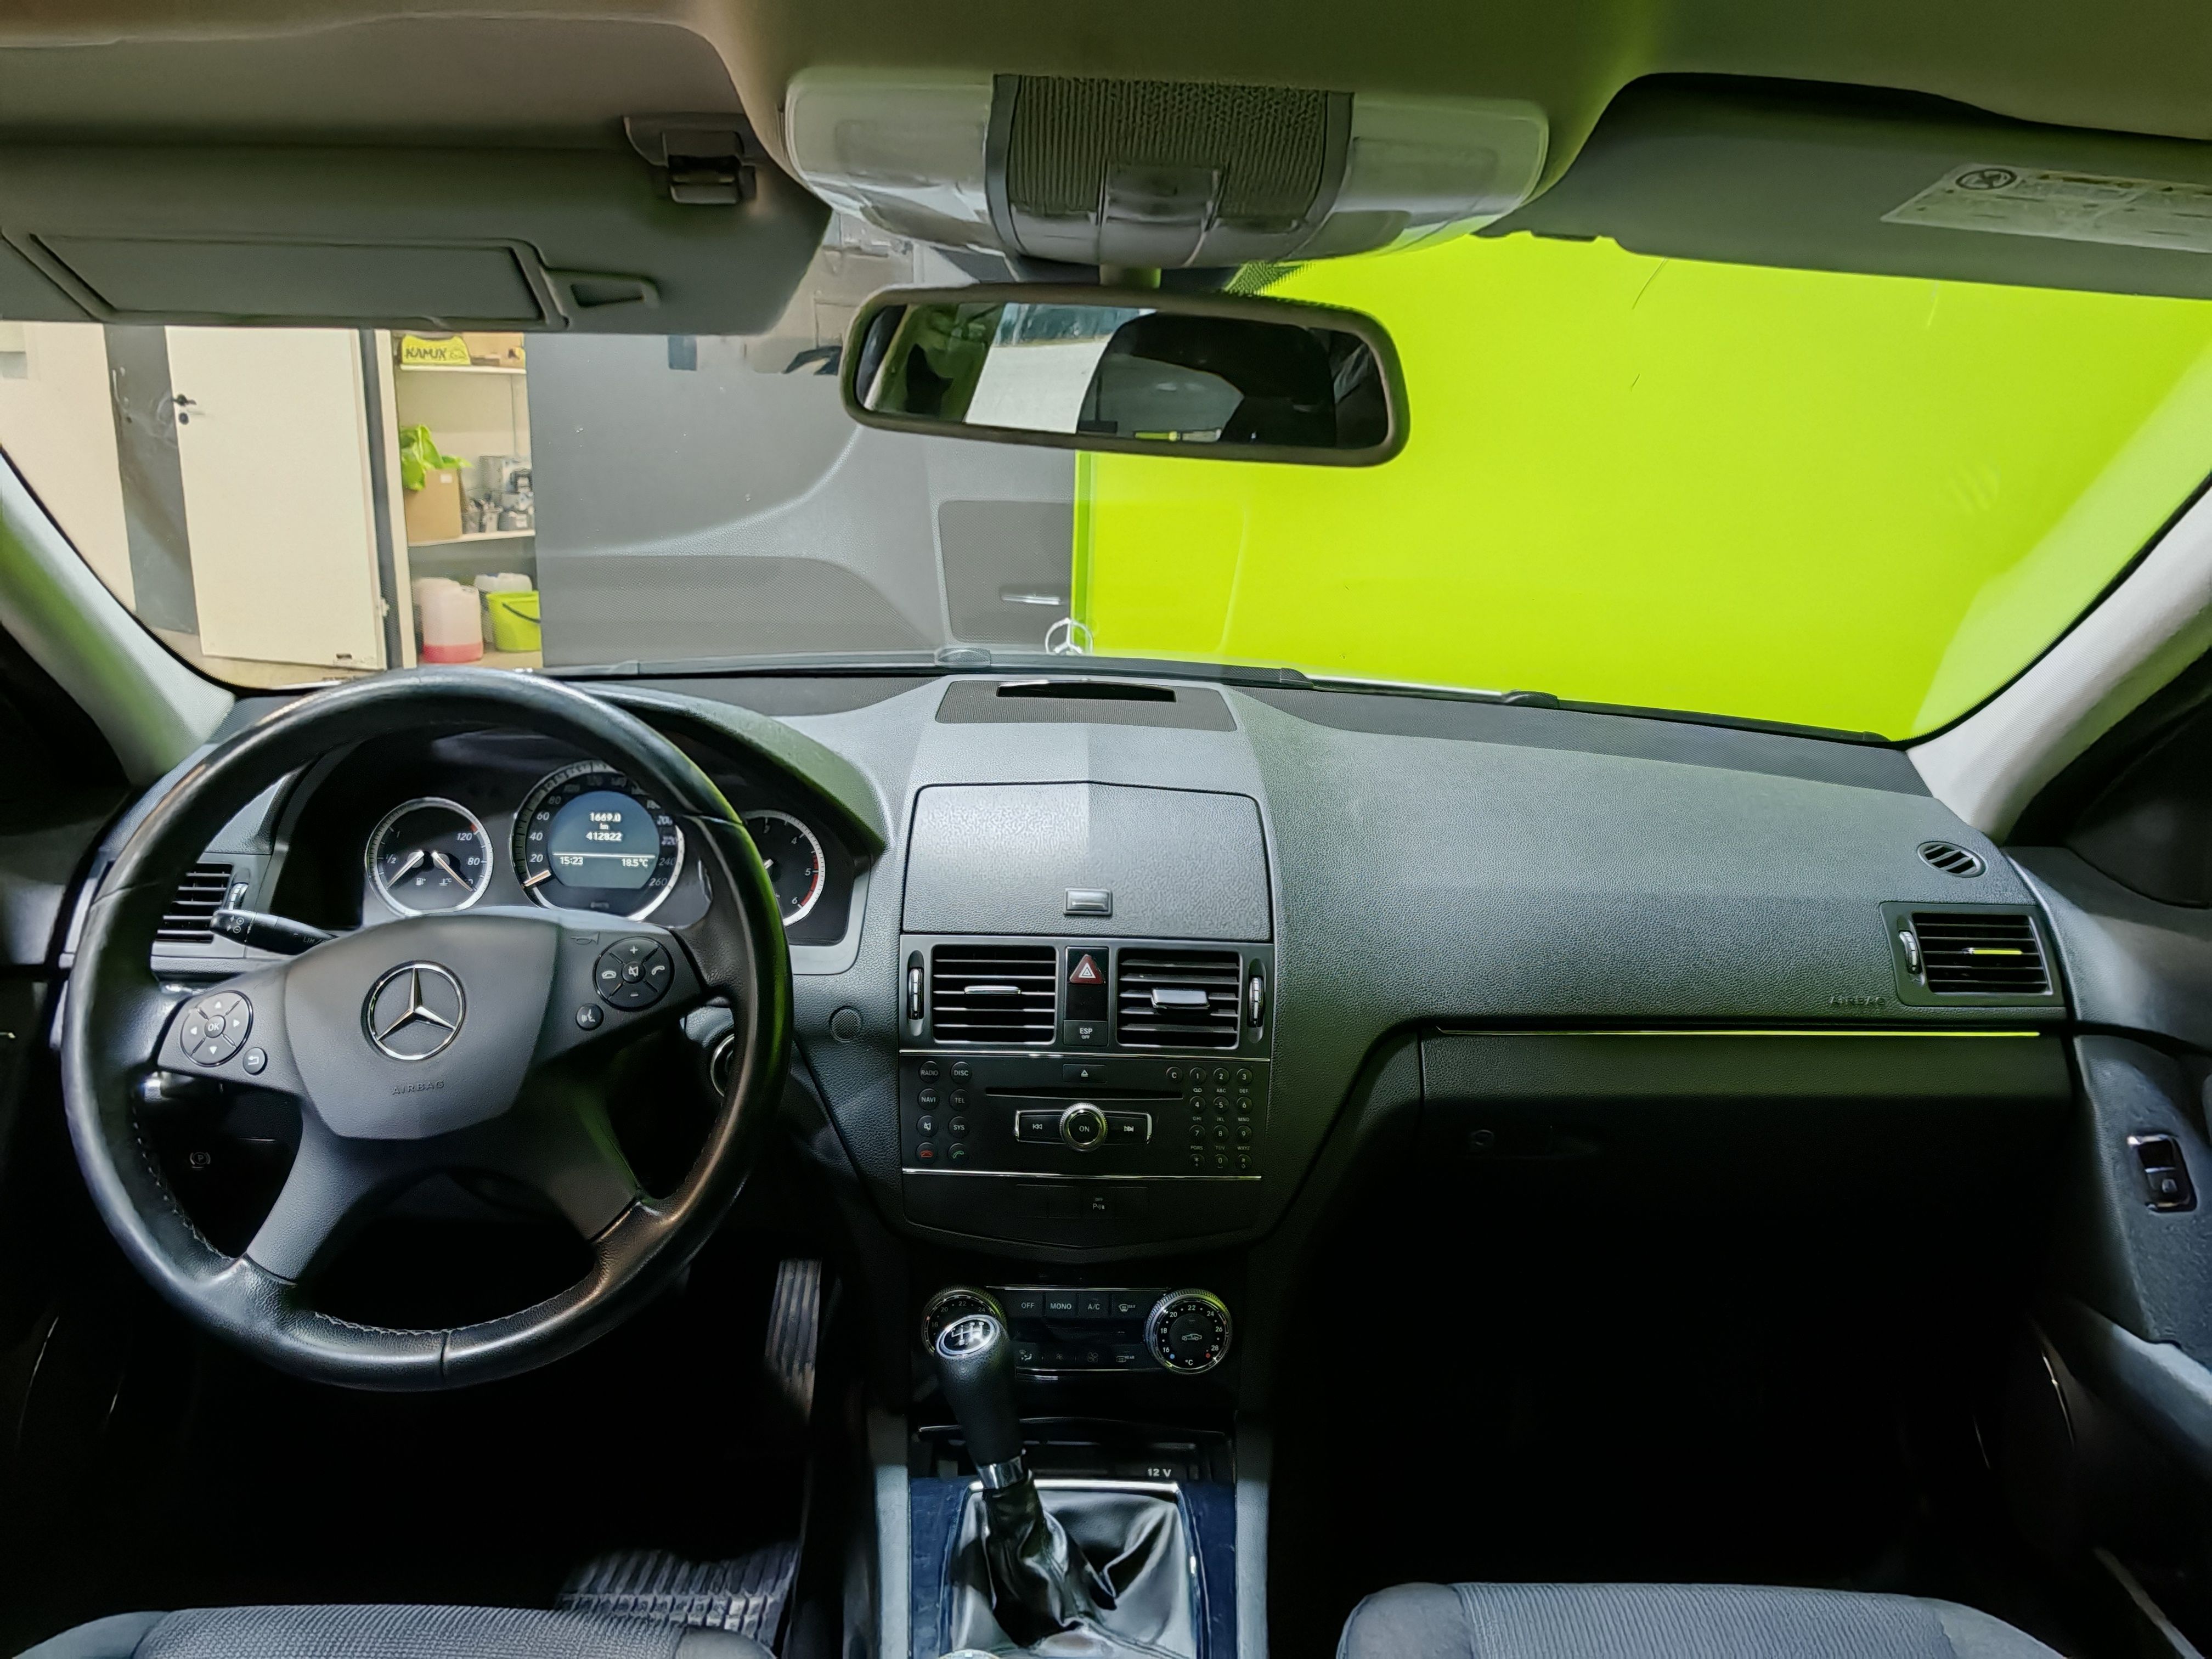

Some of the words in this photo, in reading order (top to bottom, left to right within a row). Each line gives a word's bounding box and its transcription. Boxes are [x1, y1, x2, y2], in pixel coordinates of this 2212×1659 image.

[537, 812, 549, 821] 60
[457, 832, 472, 841] 120
[529, 832, 543, 841] 40
[586, 832, 622, 842] 412822
[530, 854, 543, 863] 20
[560, 856, 583, 865] 15:23
[648, 878, 668, 886] 260
[392, 1080, 444, 1095] AIRBAG
[1148, 1468, 1160, 1476] 12
[1163, 1469, 1171, 1477] V
